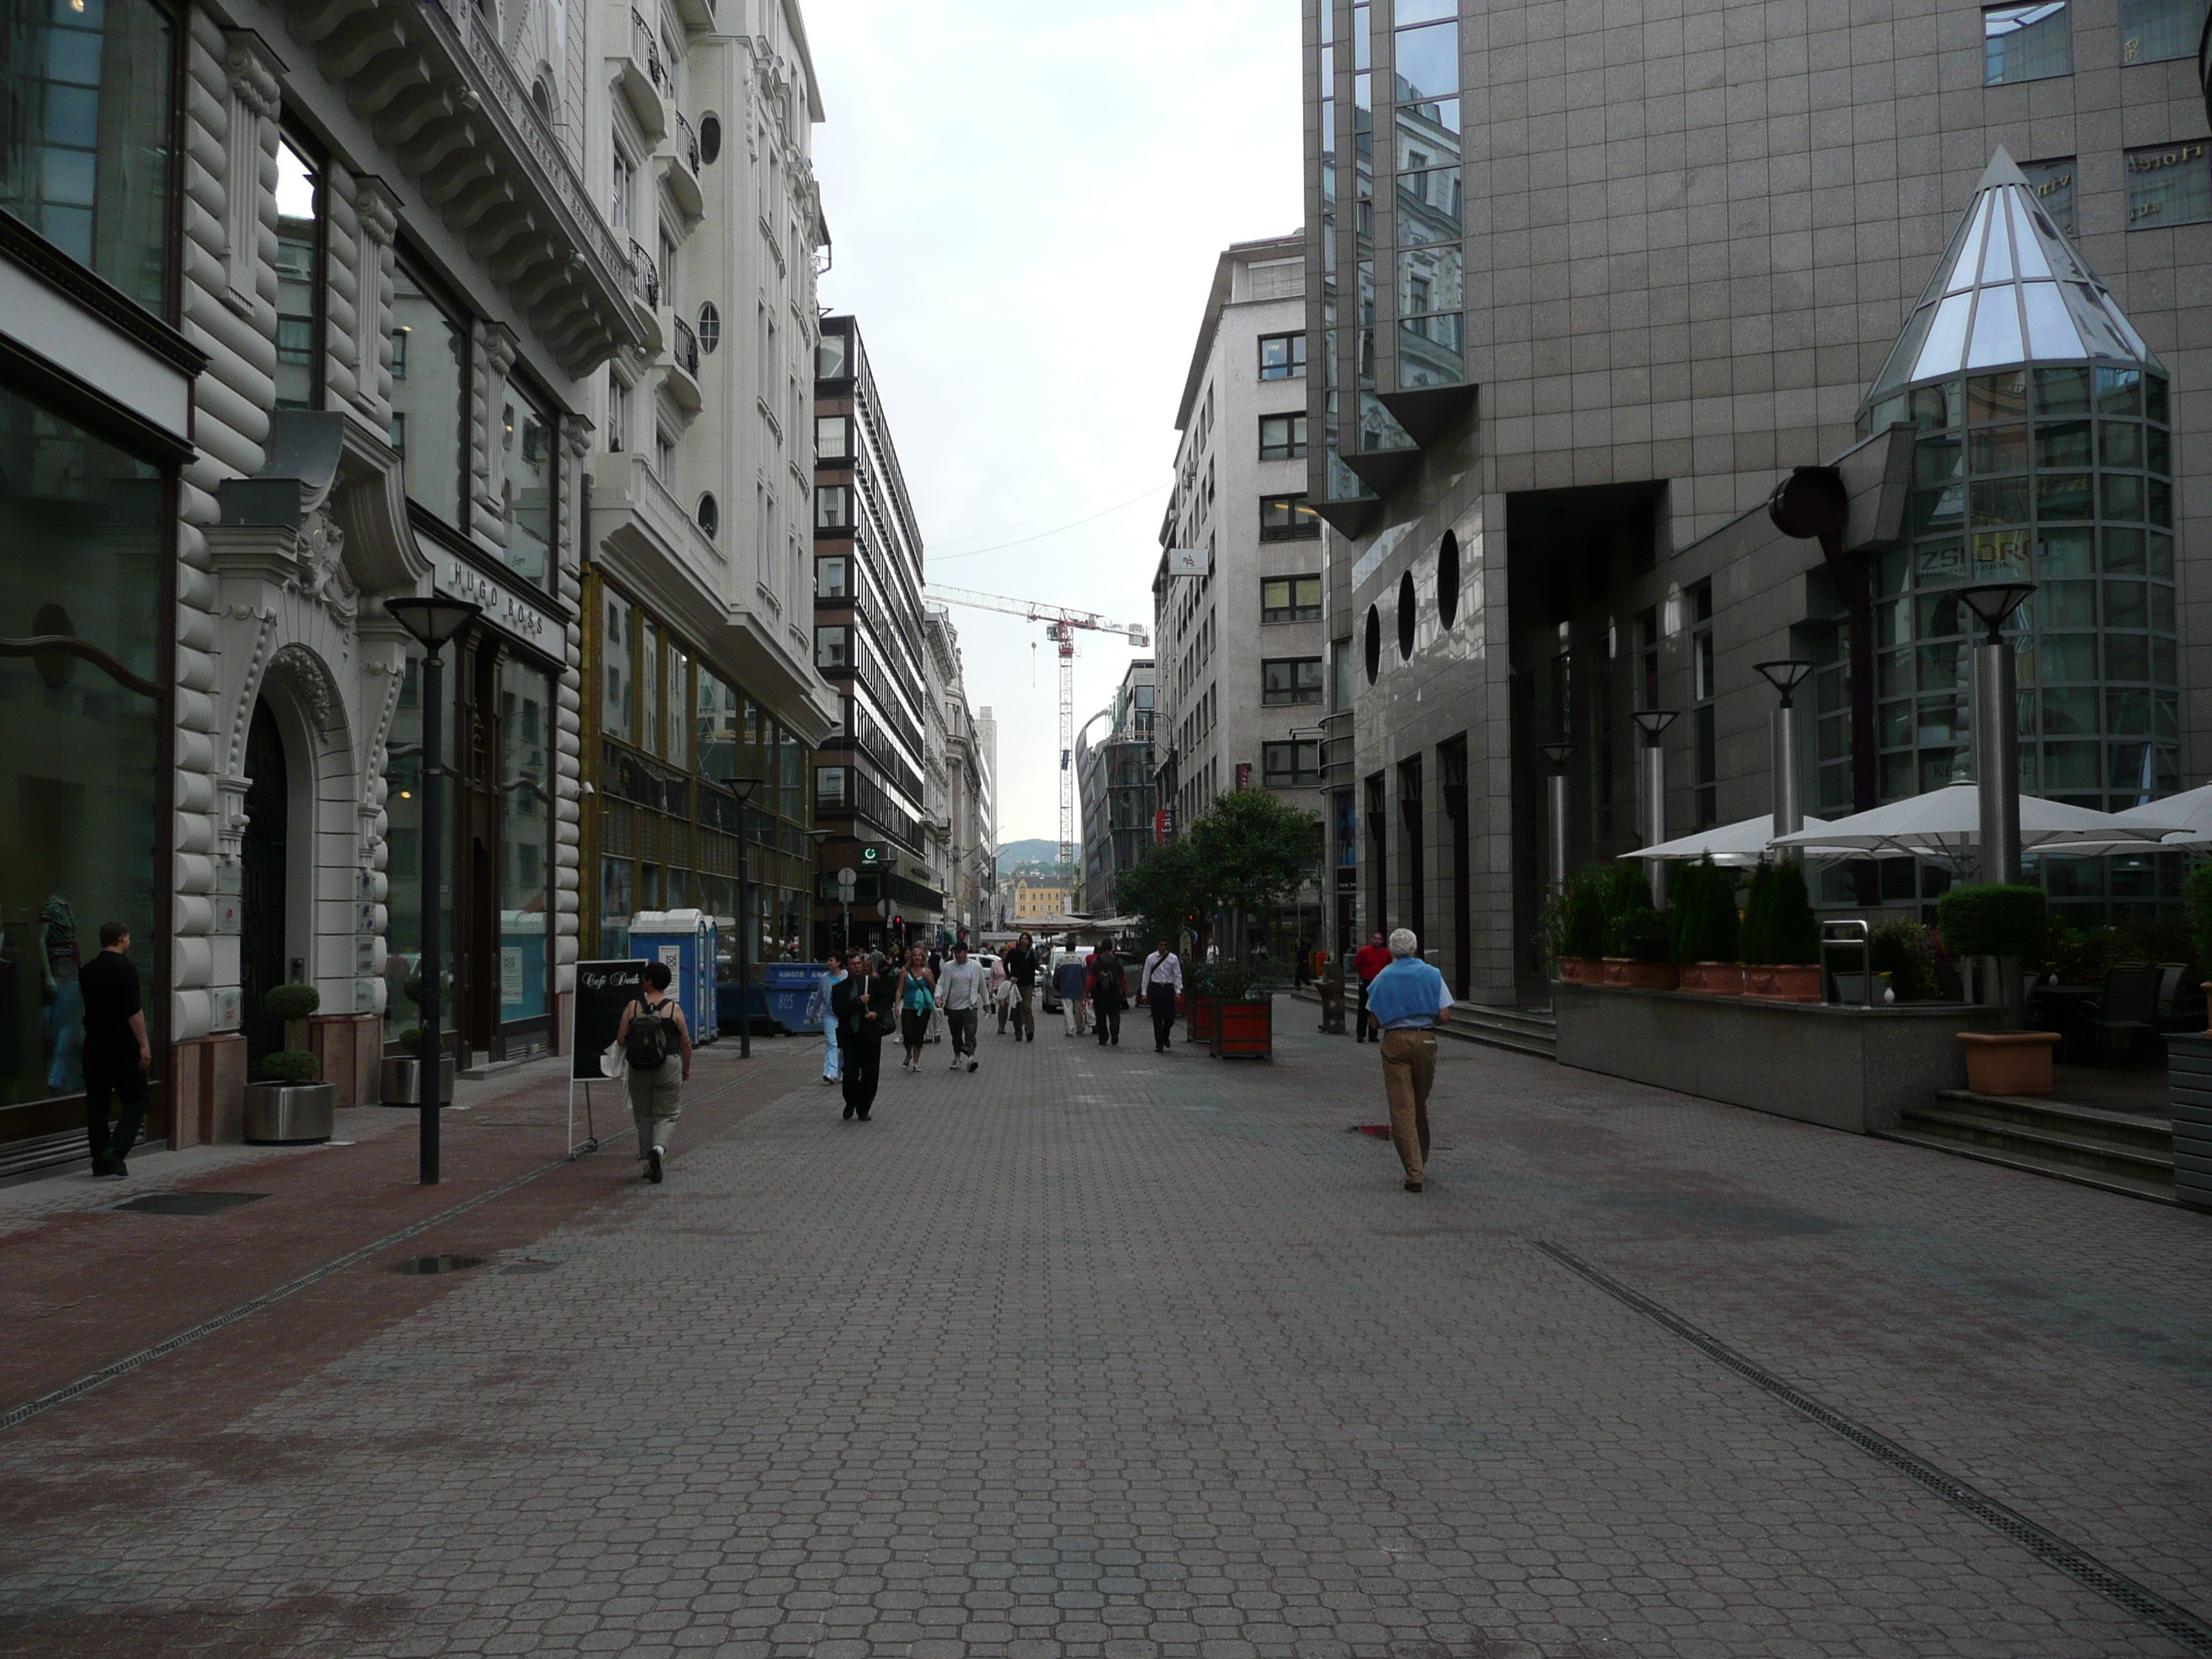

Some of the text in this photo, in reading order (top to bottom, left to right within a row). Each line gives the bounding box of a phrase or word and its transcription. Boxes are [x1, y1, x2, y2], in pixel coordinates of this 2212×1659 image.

[455, 562, 542, 634] HUGO BOSS
[778, 994, 794, 1010] 805
